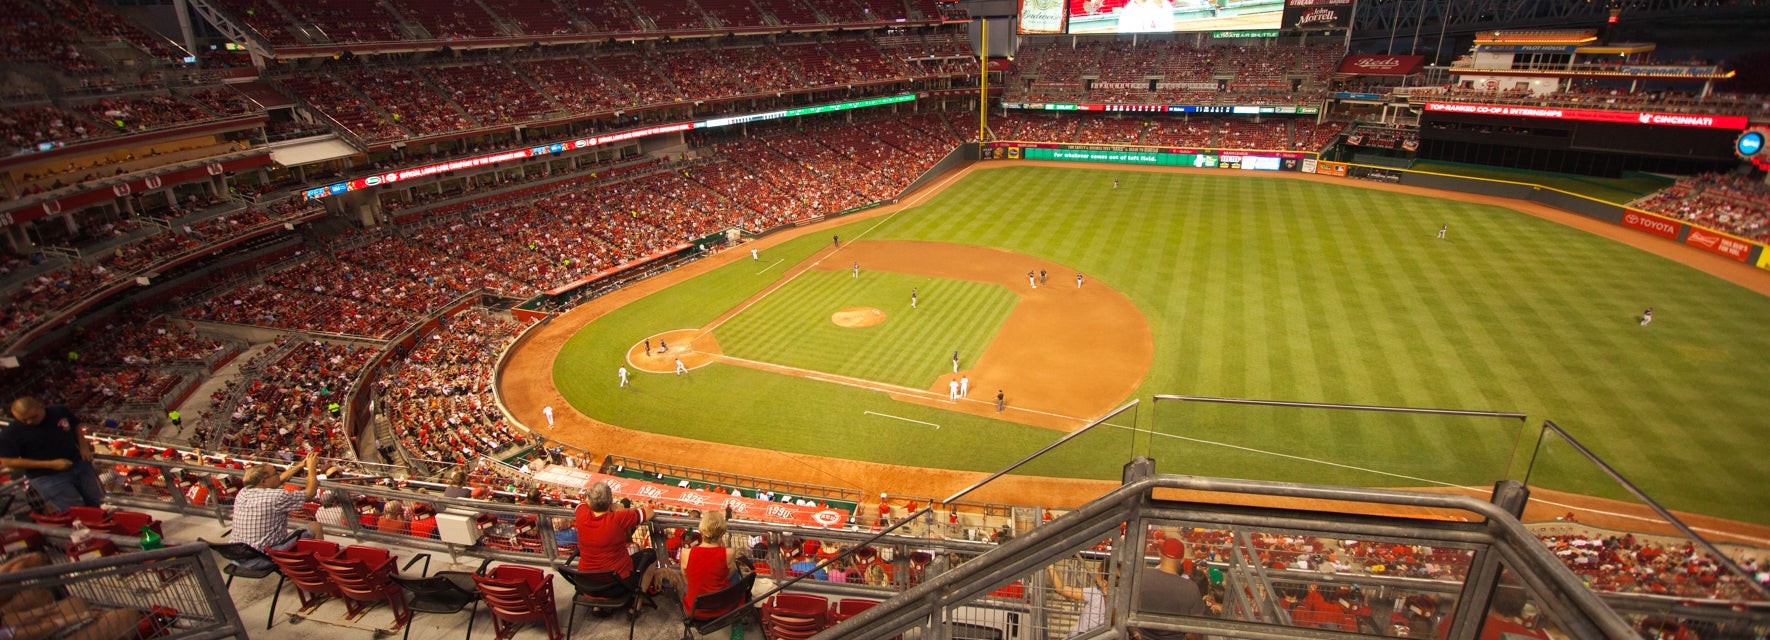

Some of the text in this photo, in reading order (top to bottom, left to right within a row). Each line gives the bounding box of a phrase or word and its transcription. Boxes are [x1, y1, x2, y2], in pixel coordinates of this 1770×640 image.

[1354, 57, 1399, 67] Reds
[1430, 103, 1476, 112] TOP-RANKED
[1477, 105, 1502, 113] CO-OP
[1510, 107, 1562, 117] INTERNSHIPS
[1653, 117, 1712, 127] CINCINNATI
[1639, 218, 1674, 234] TOYOTA
[639, 486, 661, 497] 1940
[725, 499, 746, 511] 1976
[768, 506, 790, 518] 1990
